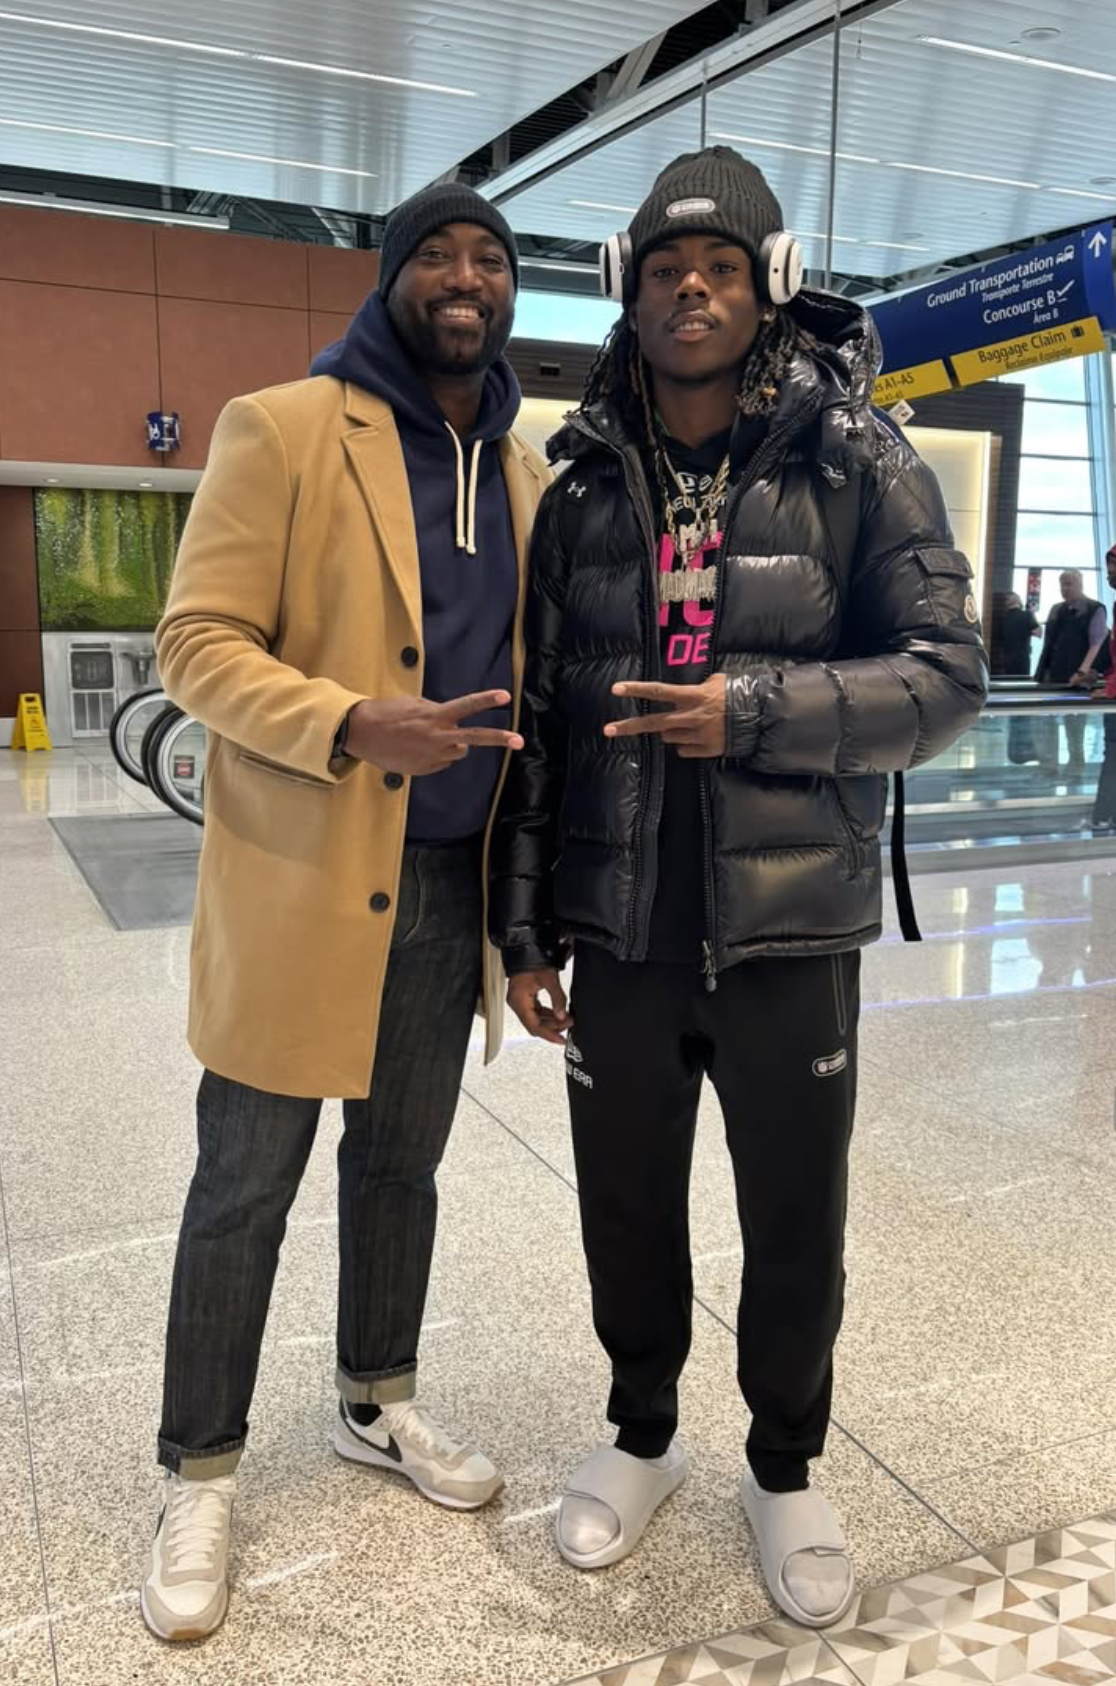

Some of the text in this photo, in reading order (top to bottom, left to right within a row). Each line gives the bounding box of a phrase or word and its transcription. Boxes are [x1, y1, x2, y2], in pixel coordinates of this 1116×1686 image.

[926, 255, 1054, 307] Ground Transportation
[982, 290, 1056, 324] Concourse B
[1052, 308, 1060, 318] B
[977, 343, 1028, 363] Baggage
[1030, 331, 1067, 349] Claim
